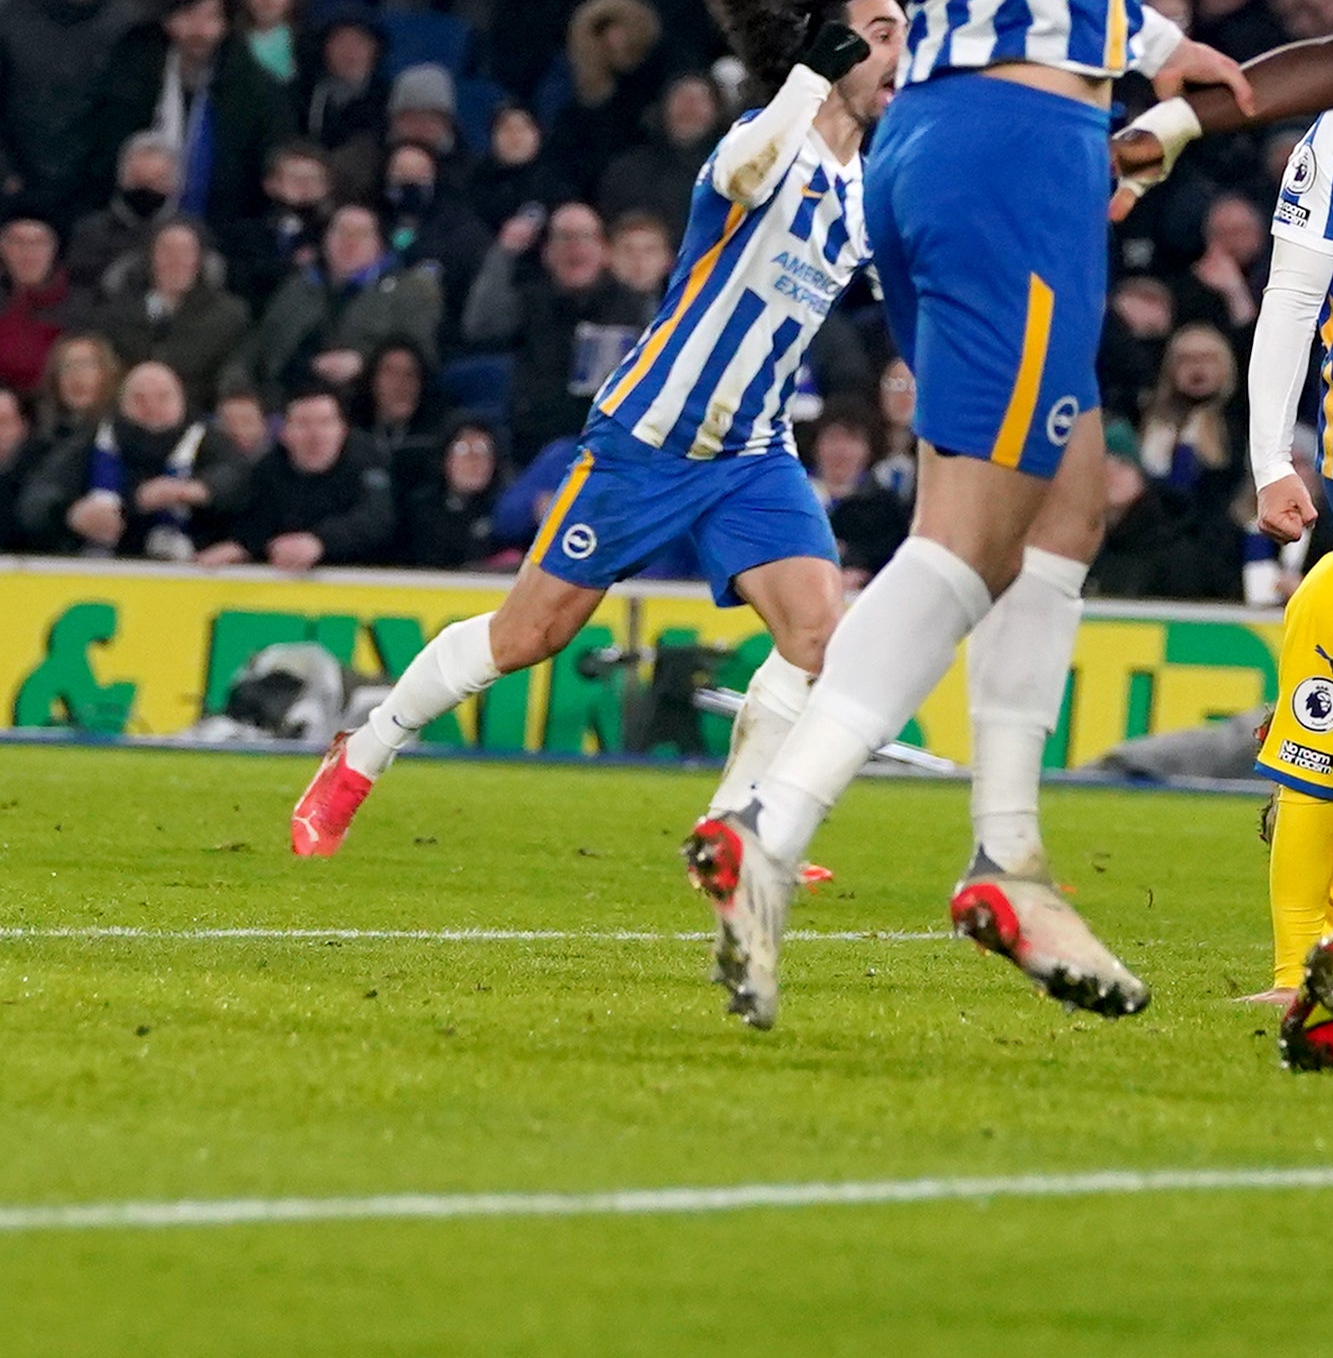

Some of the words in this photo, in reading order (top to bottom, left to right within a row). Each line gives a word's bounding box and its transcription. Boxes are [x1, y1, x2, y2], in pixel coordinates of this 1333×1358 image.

[770, 251, 843, 295] AMERIC
[12, 601, 137, 733] &
[1280, 740, 1299, 756] No
[1298, 749, 1331, 766] room
